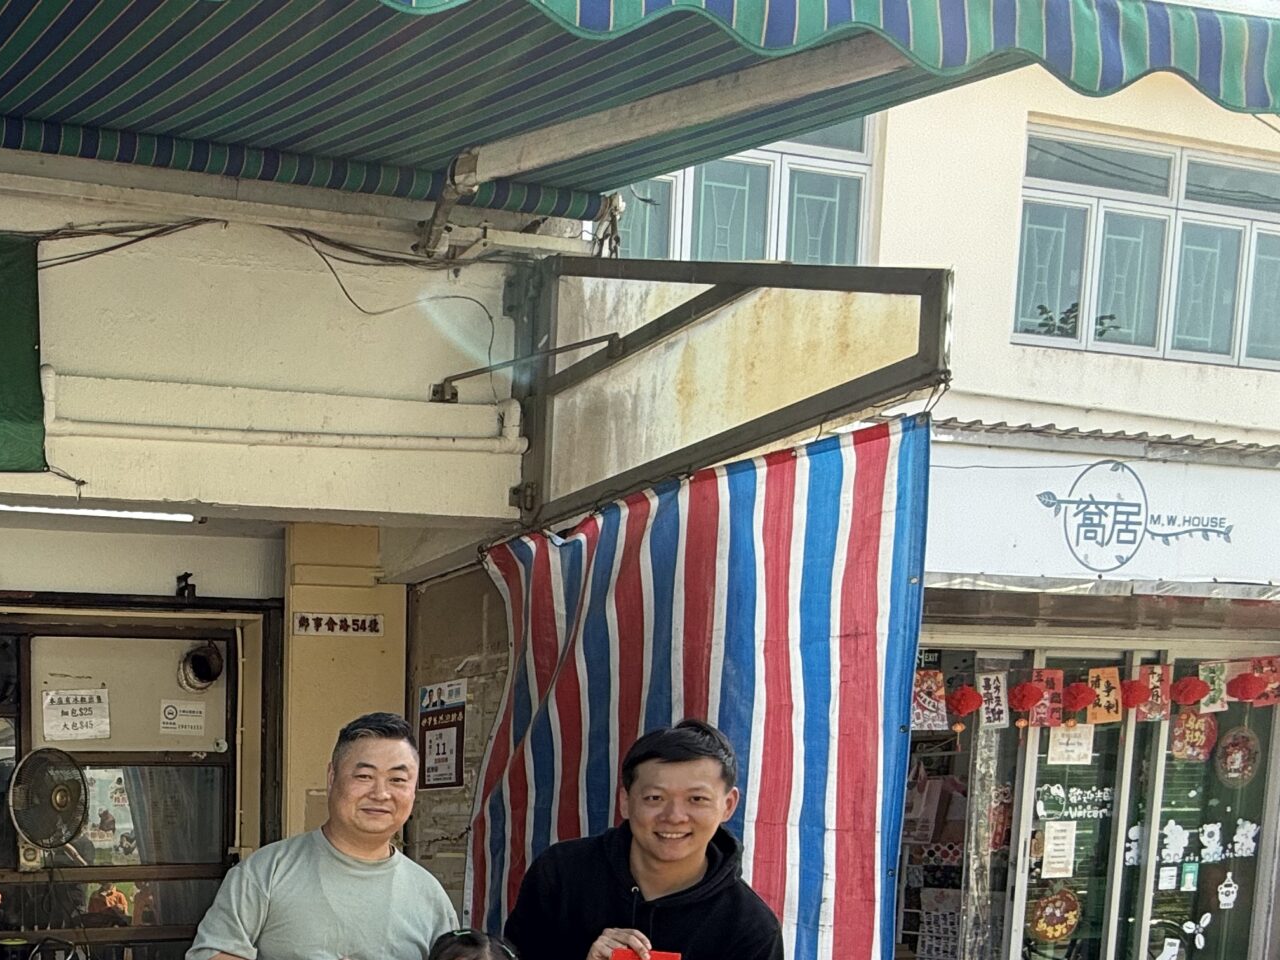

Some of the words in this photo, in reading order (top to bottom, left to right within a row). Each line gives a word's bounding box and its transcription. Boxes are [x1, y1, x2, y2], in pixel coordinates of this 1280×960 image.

[298, 615, 380, 632] 鄉事會路54號
